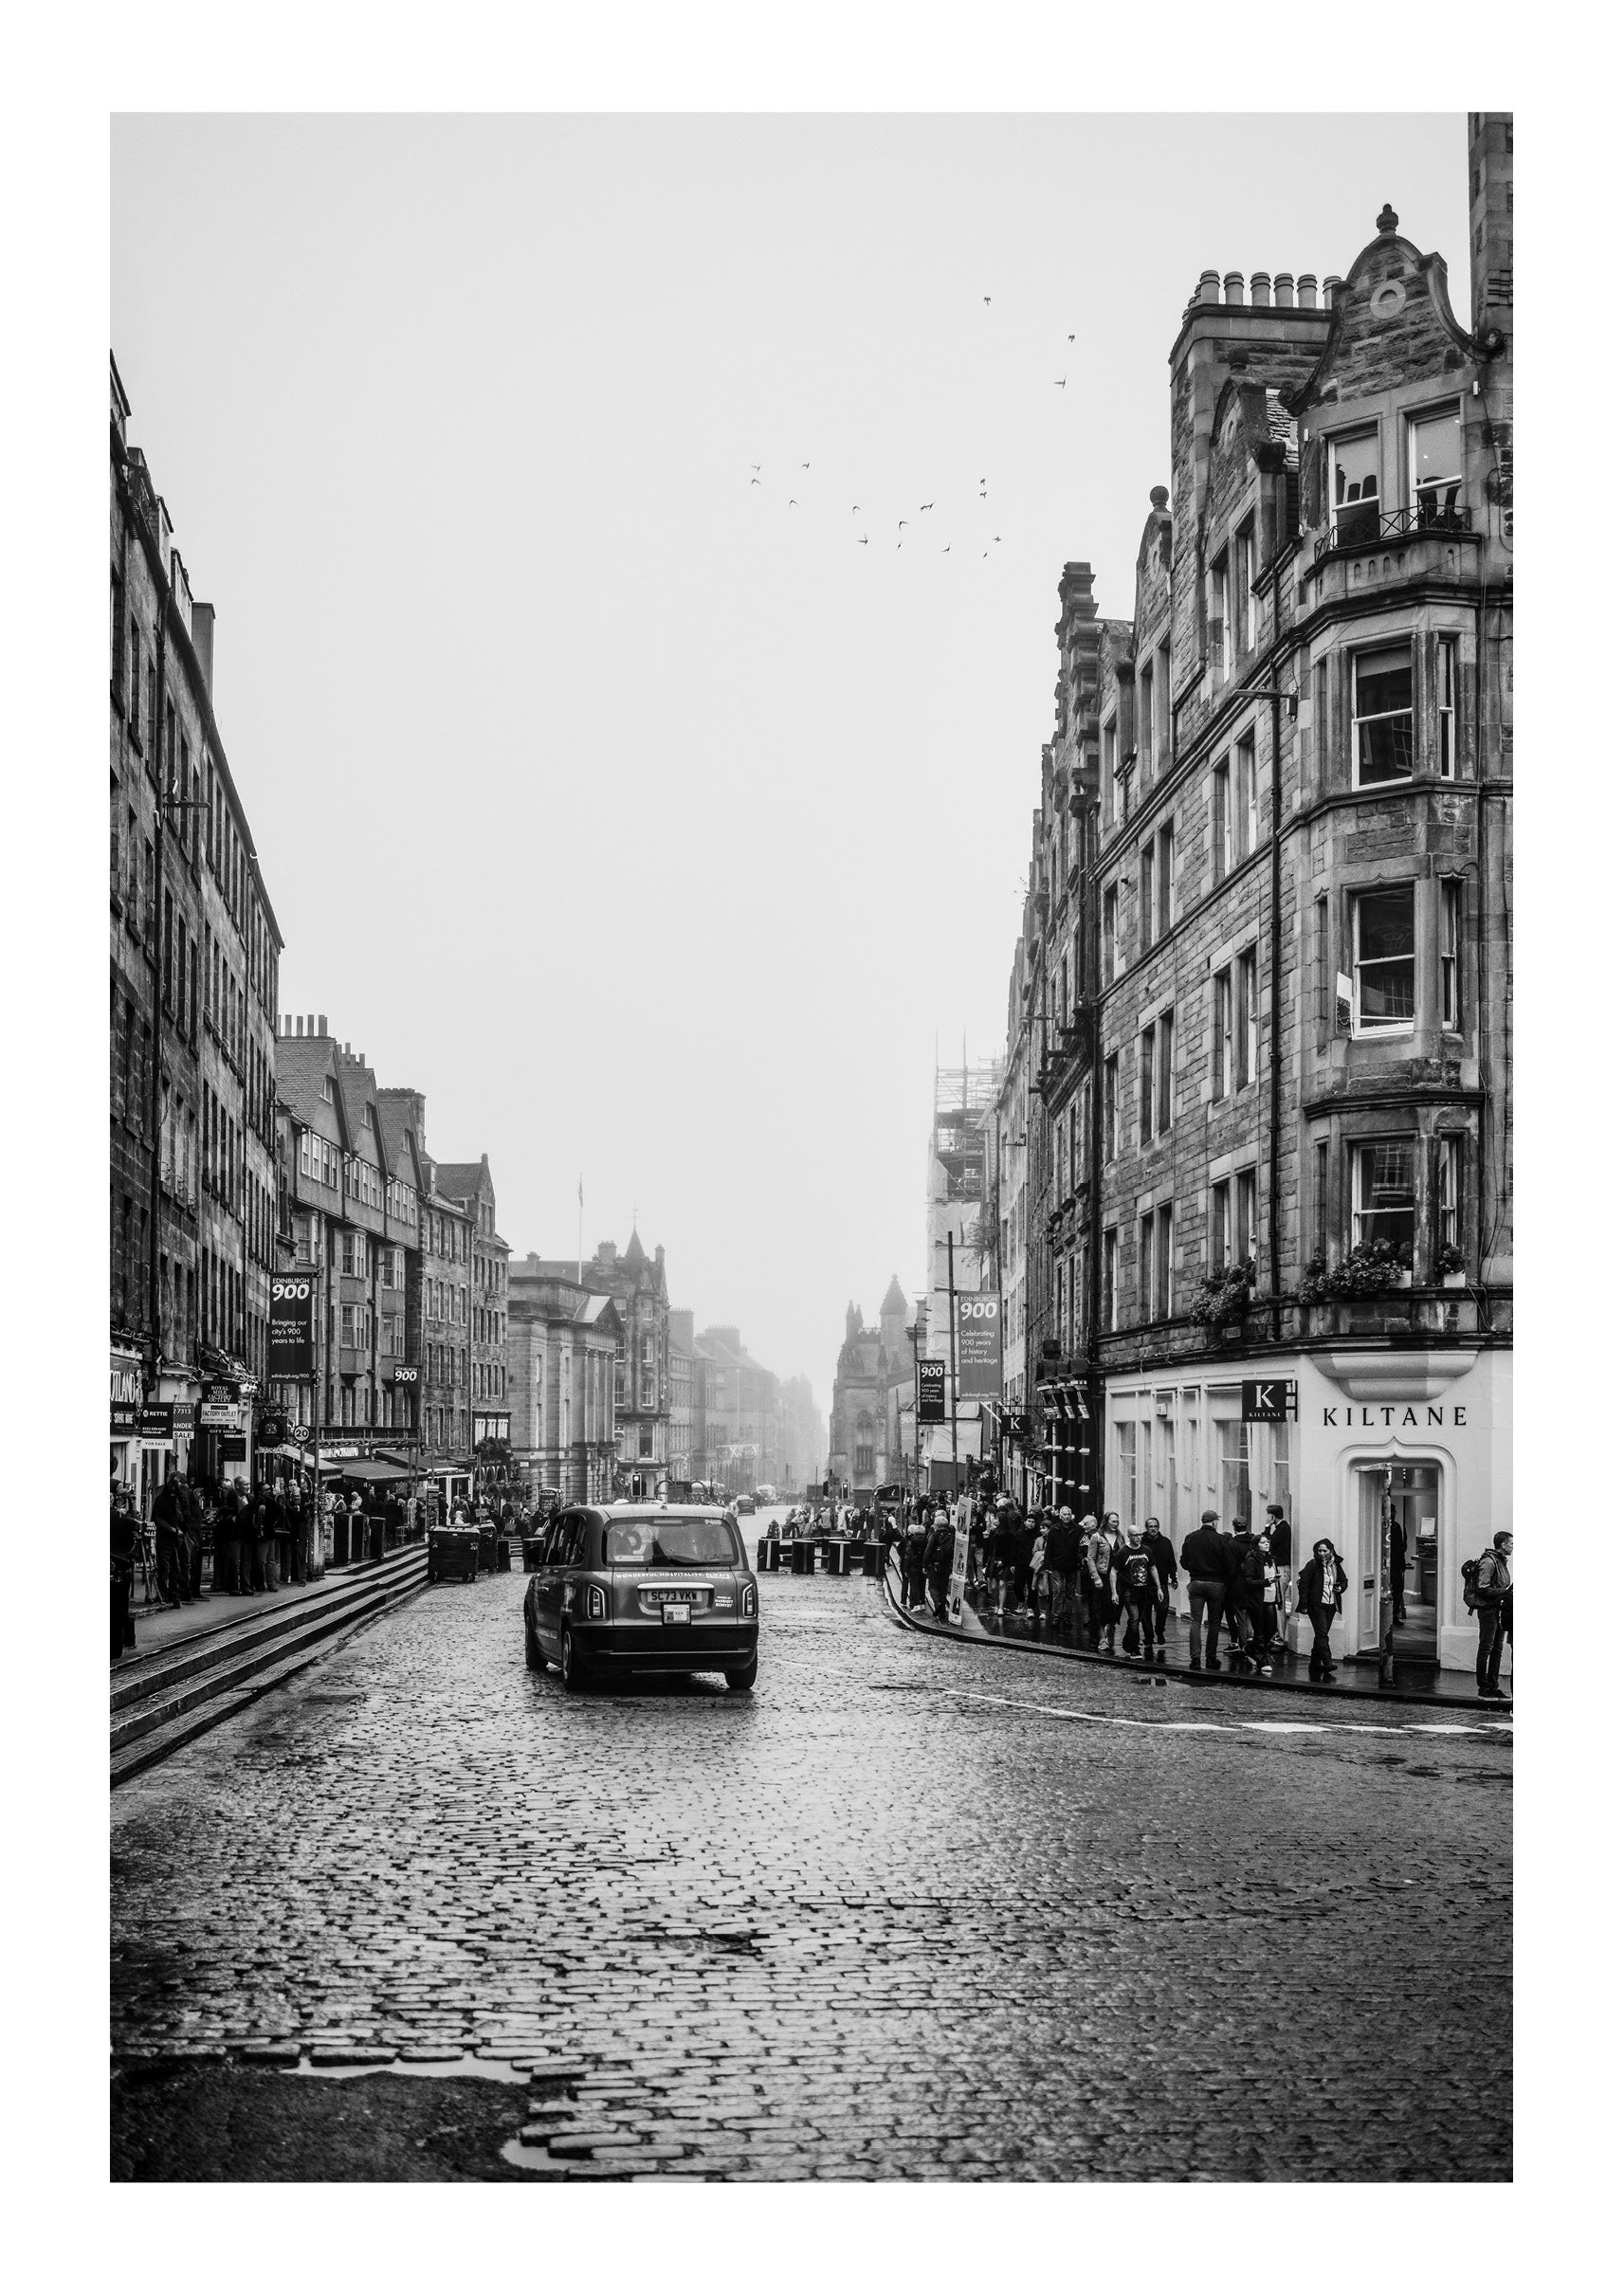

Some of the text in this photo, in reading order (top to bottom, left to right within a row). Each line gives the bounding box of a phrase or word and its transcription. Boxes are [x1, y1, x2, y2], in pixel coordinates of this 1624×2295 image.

[272, 1284, 310, 1302] 900
[961, 1302, 998, 1321] 900
[272, 1319, 296, 1327] Bringing
[968, 1348, 988, 1357] history
[974, 1357, 998, 1366] heritage
[394, 1371, 418, 1381] 900
[921, 1367, 944, 1377] 900
[1256, 1385, 1275, 1408] K
[1323, 1407, 1468, 1426] KILTANE
[1010, 1417, 1021, 1430] K
[296, 1430, 308, 1438] 20
[651, 1592, 698, 1601] SC73 VKW
